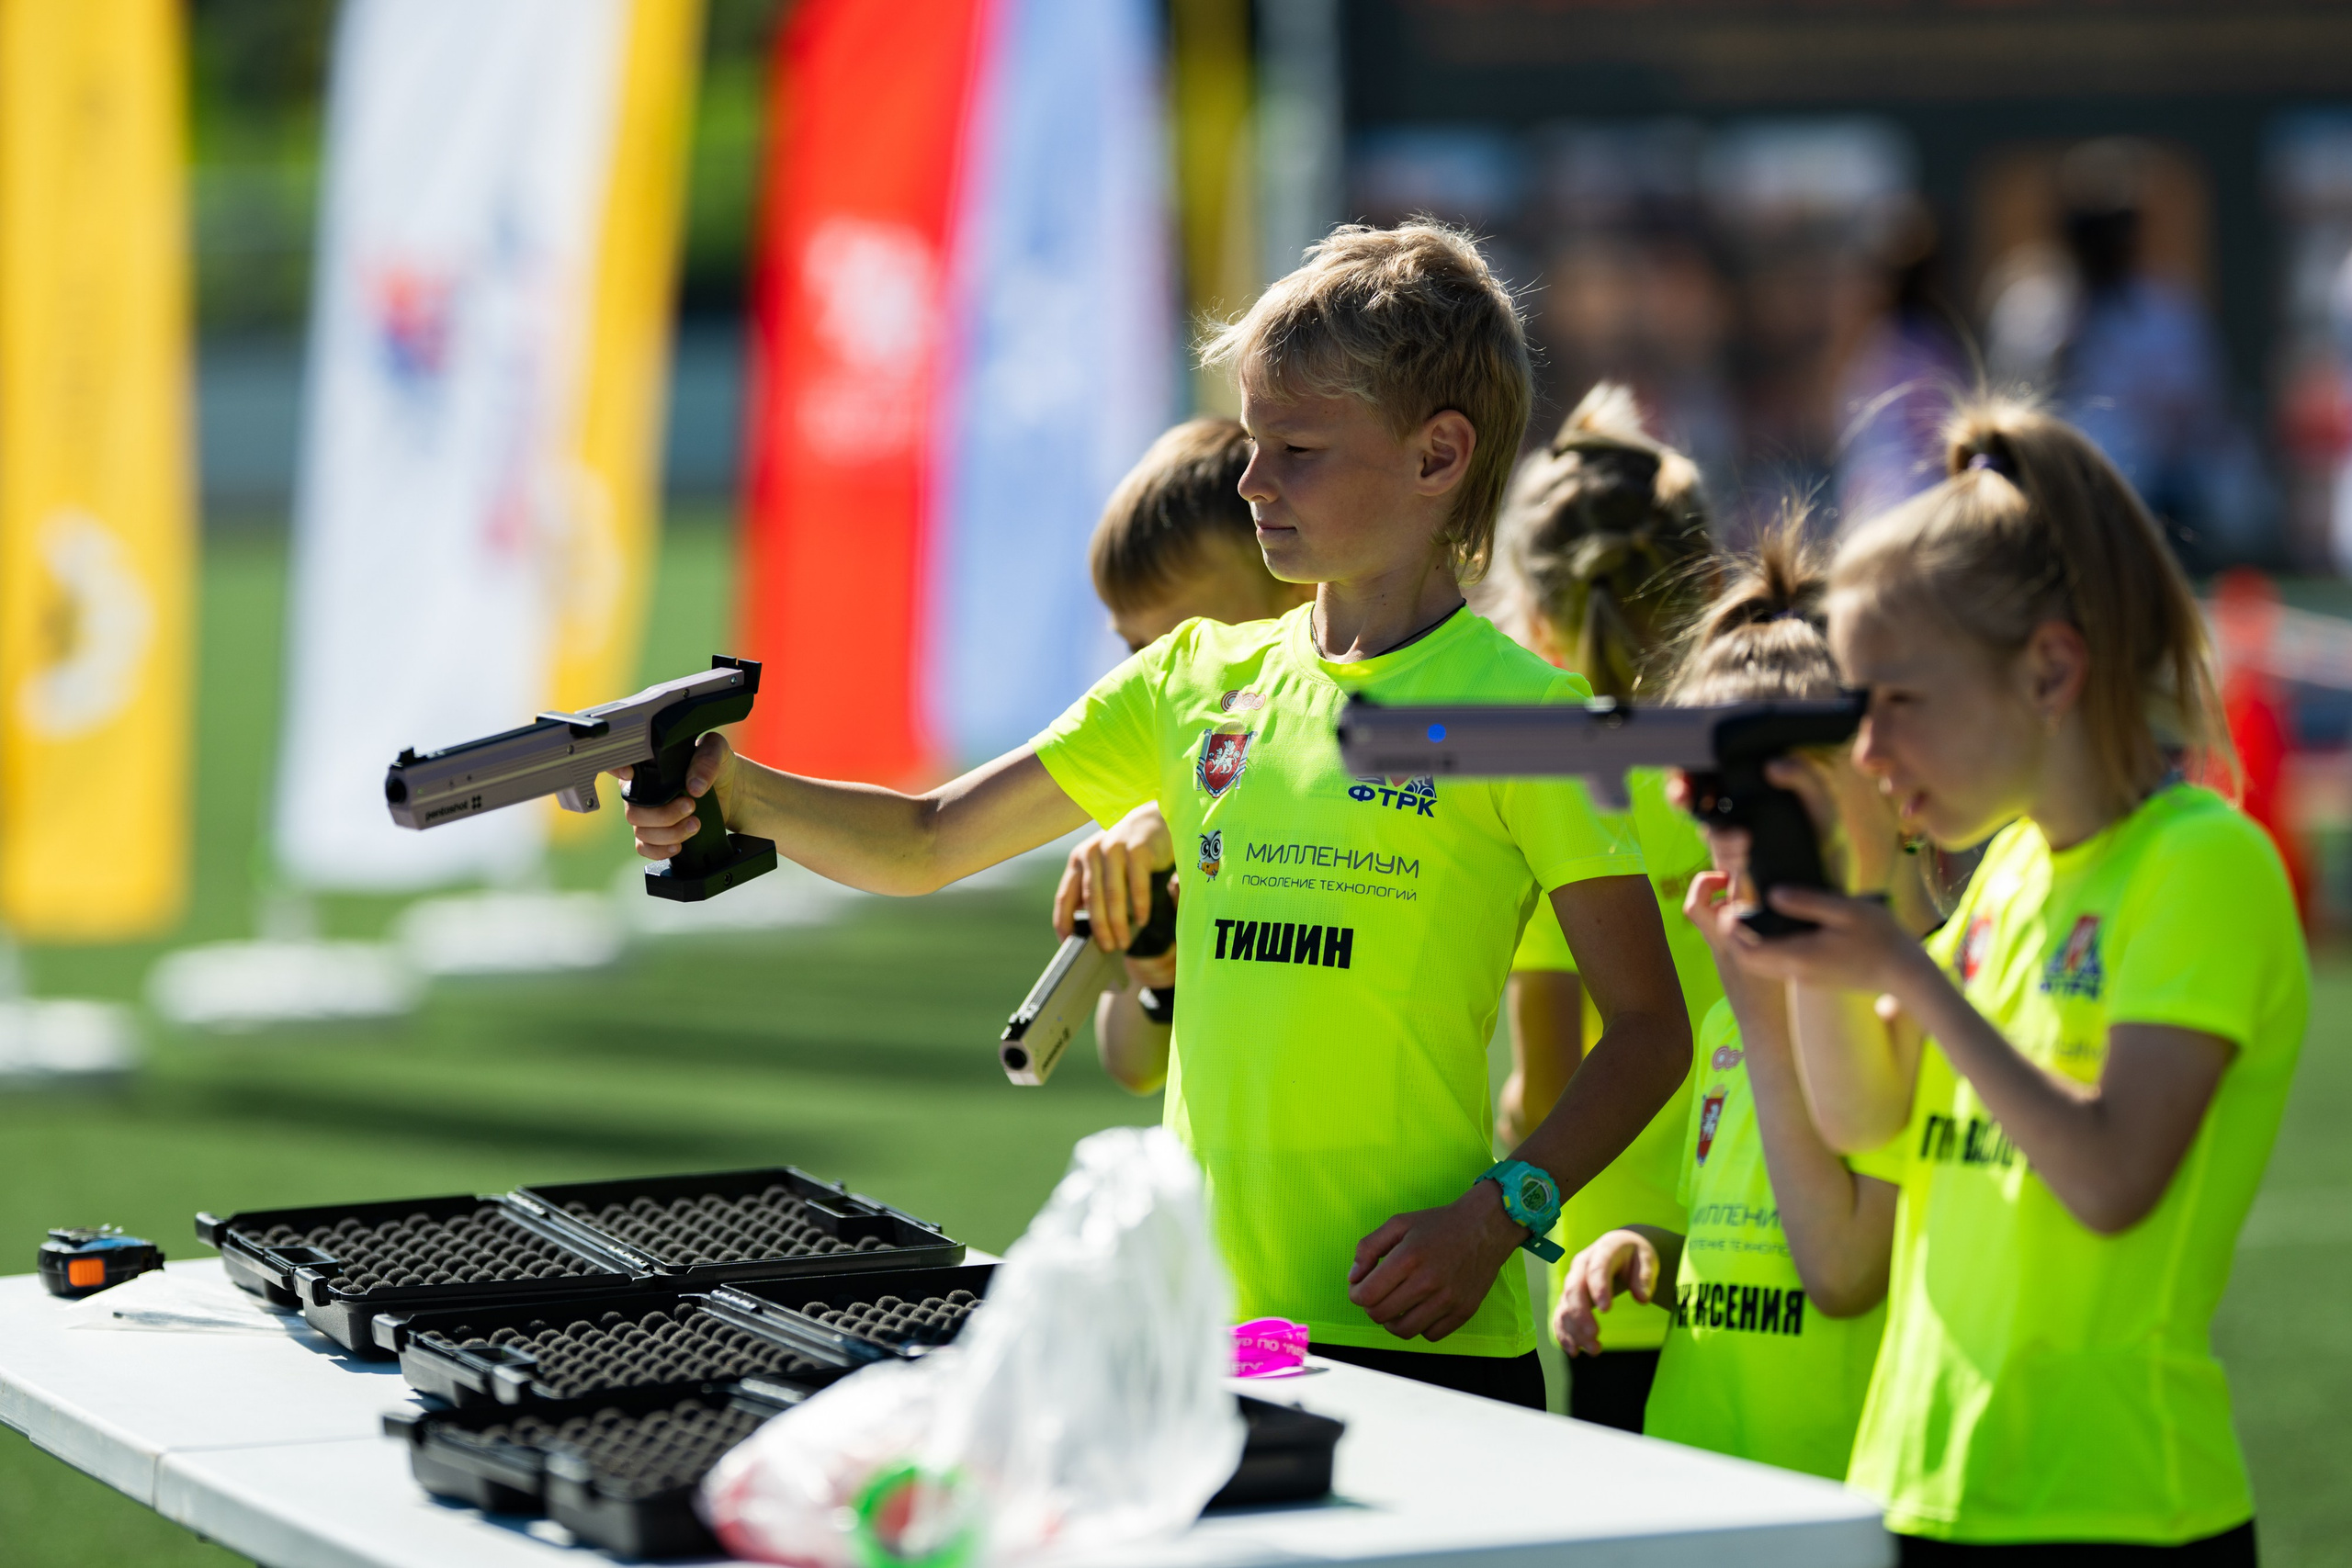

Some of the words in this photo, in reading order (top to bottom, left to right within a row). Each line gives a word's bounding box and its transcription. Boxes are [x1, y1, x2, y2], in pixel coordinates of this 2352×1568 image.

[1348, 784, 1438, 818] ФТРК
[1246, 842, 1419, 878] МИЛЛЕНИУМ
[1241, 874, 1317, 889] ПОКОЛЕНИЕ
[1319, 879, 1417, 901] ТЕХНОЛОГИЙ
[1215, 919, 1354, 969] ТИШИН
